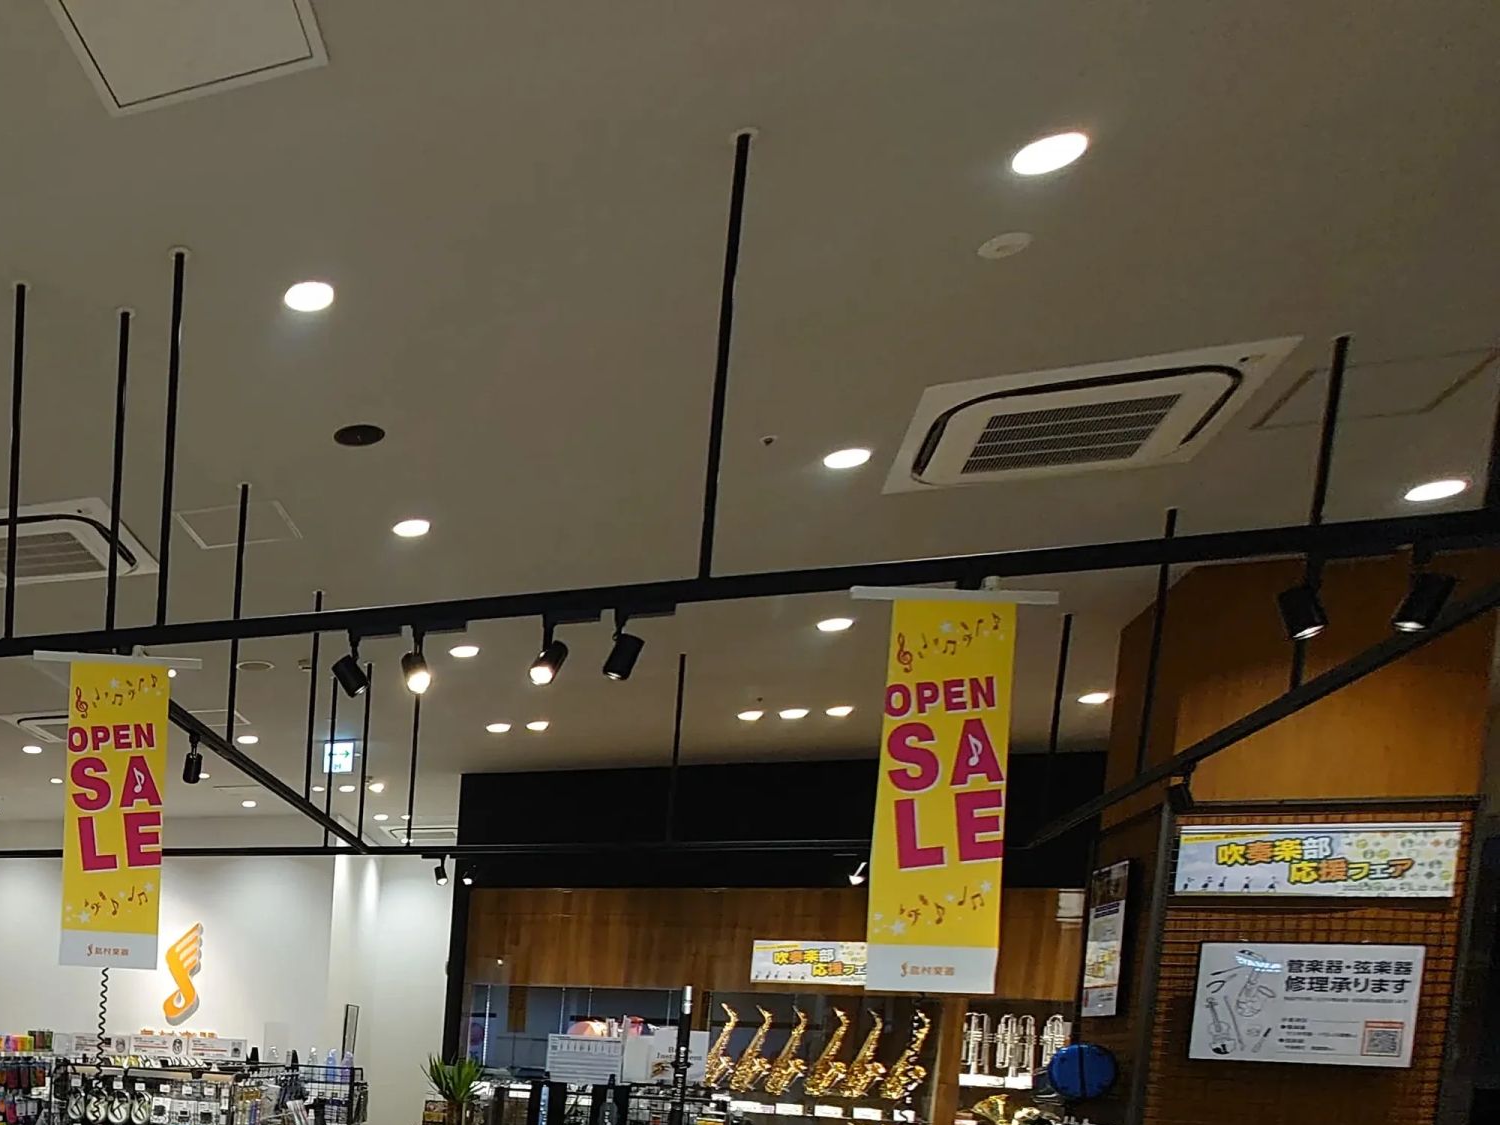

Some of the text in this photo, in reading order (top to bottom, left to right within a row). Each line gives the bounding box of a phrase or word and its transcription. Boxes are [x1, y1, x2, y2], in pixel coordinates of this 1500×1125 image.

[884, 676, 996, 717] OPEN
[68, 723, 156, 752] OPEN
[1216, 836, 1331, 866] 吹奏楽部
[1288, 858, 1414, 884] 応援フェア
[812, 961, 867, 977] 応援フェ
[1287, 960, 1413, 975] 管楽器・弦楽器
[1285, 976, 1411, 993] 修理承ります
